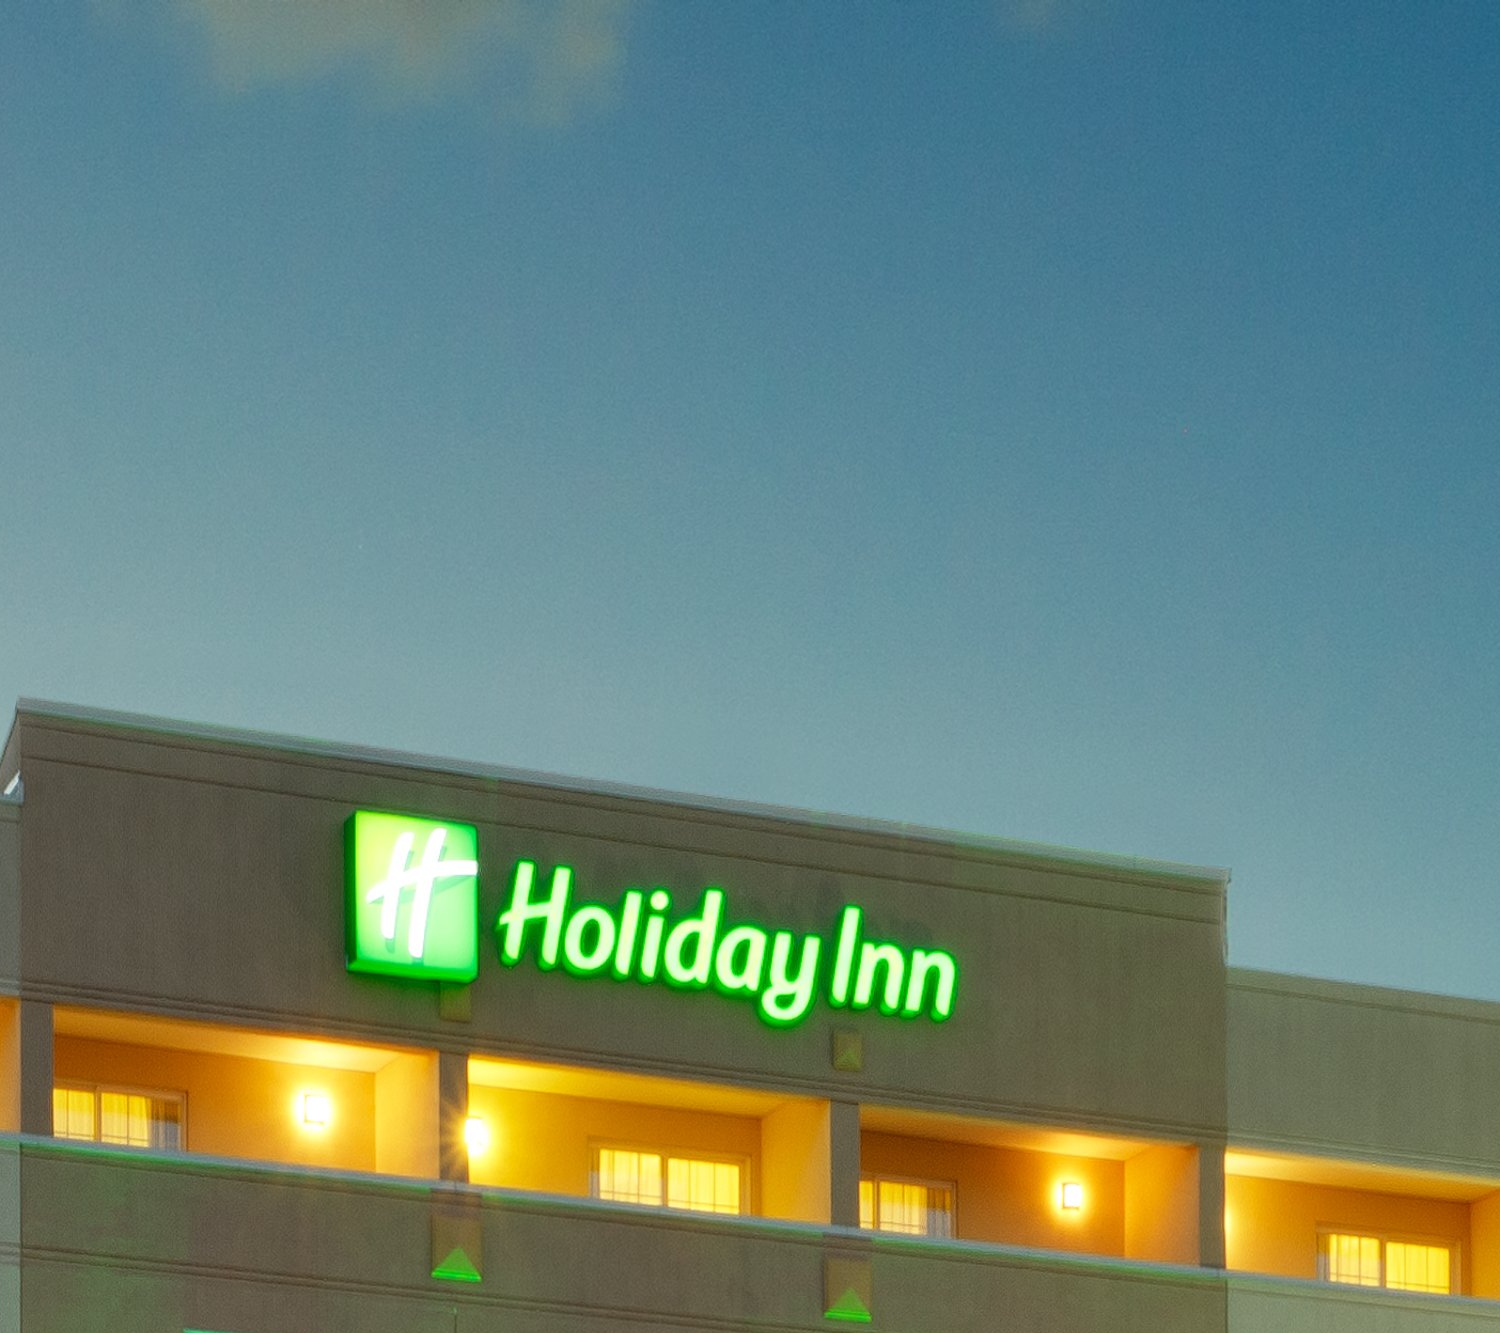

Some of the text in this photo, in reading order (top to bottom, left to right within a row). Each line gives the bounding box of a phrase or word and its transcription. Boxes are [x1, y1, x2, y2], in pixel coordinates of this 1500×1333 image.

[364, 827, 479, 959] H
[497, 860, 957, 1023] Holiday Inn
